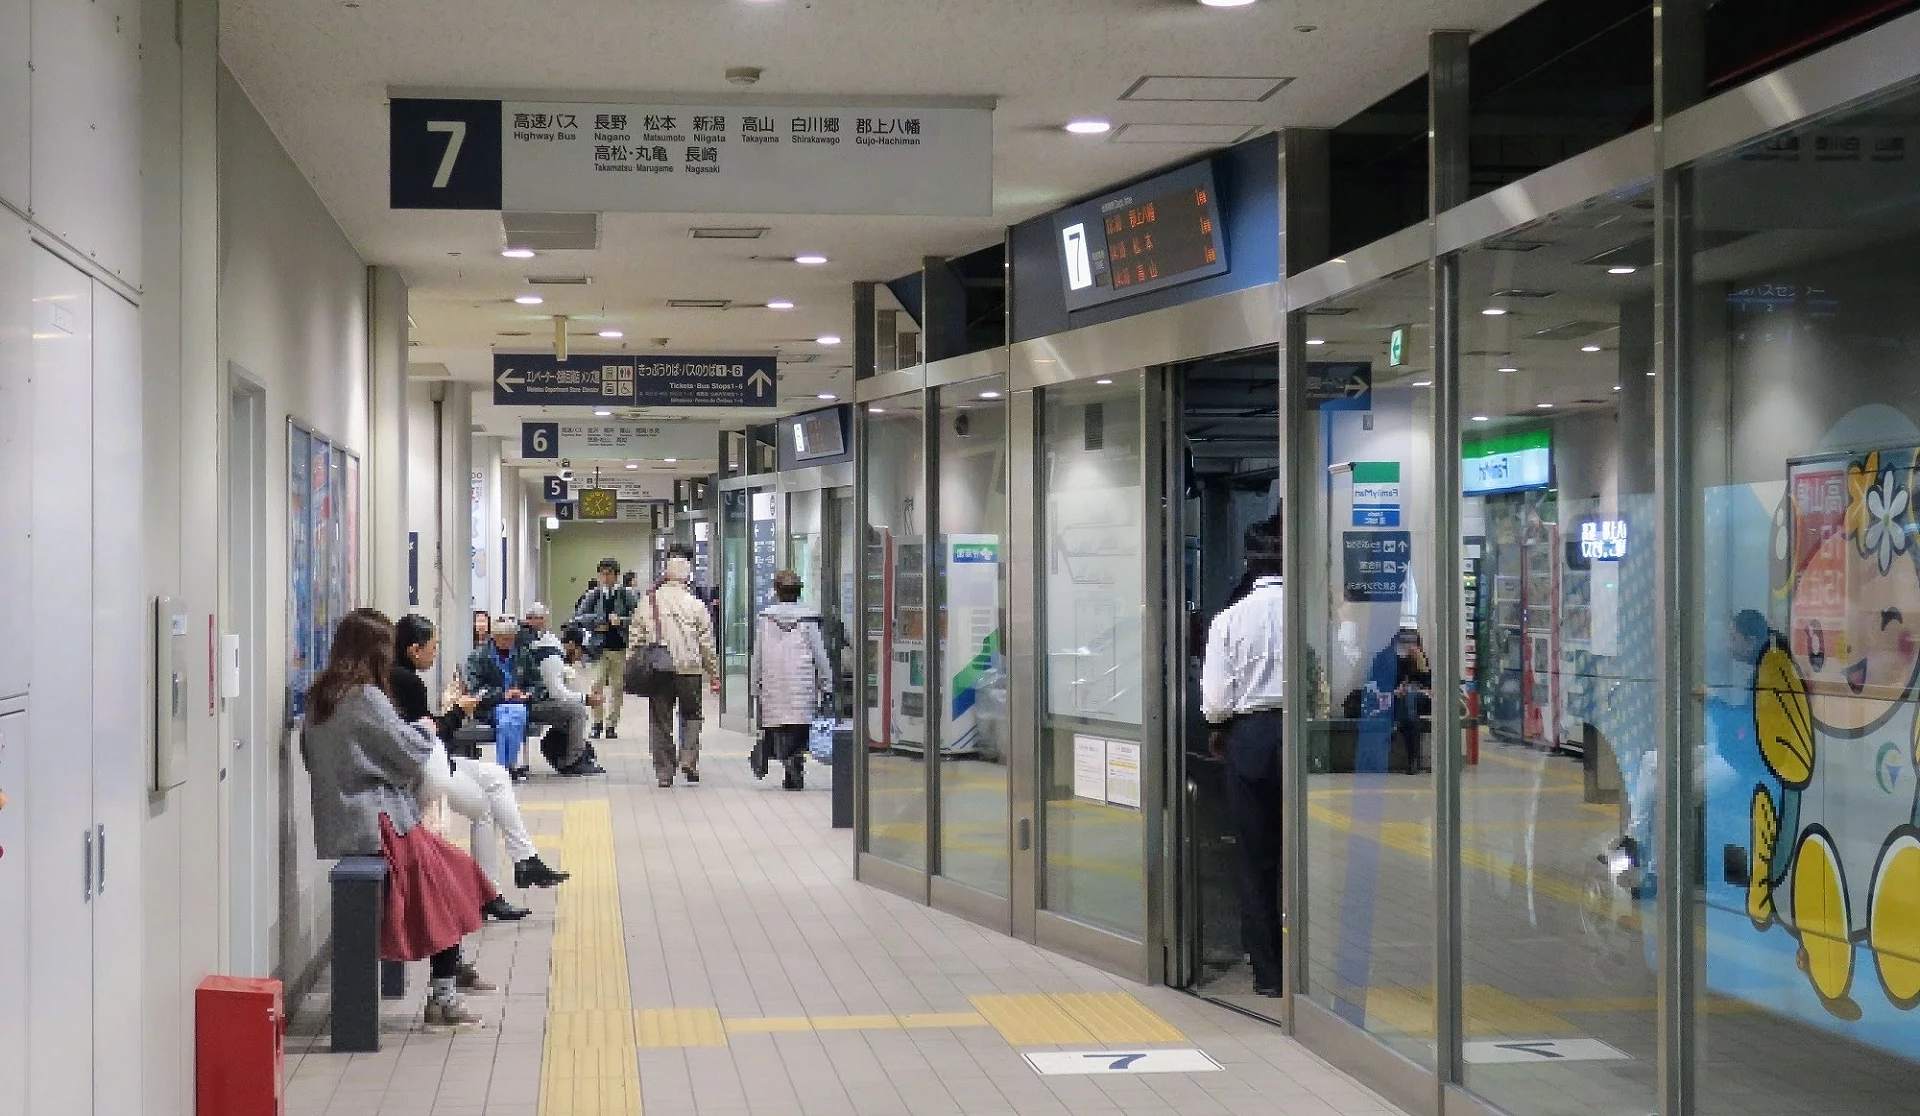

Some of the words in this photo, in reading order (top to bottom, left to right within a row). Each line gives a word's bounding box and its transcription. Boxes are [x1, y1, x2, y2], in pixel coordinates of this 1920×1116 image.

[513, 113, 579, 130] 高速バス
[594, 114, 628, 131] 長野
[643, 115, 677, 132] 松本
[692, 115, 726, 132] 新潟
[741, 116, 775, 133] 高山
[791, 116, 840, 133] 白川郷
[855, 118, 921, 135] 郡上八幡
[513, 131, 555, 143] Highway
[557, 132, 577, 141] Bus
[594, 132, 631, 143] Nagano
[643, 133, 686, 143] Matsumoto
[693, 134, 726, 144] Niigata
[741, 135, 780, 145] Takayama
[791, 135, 841, 146] Shirakawago
[855, 136, 921, 147] Gujo-Hachiman
[427, 120, 466, 188] 7
[594, 145, 668, 162] 高松・丸亀
[685, 146, 718, 163] 長崎
[685, 164, 721, 175] Nagasaki
[1068, 231, 1081, 283] 7
[532, 428, 548, 452] 6
[550, 479, 561, 496] 5
[560, 505, 568, 517] 4
[1082, 1053, 1147, 1070] 7
